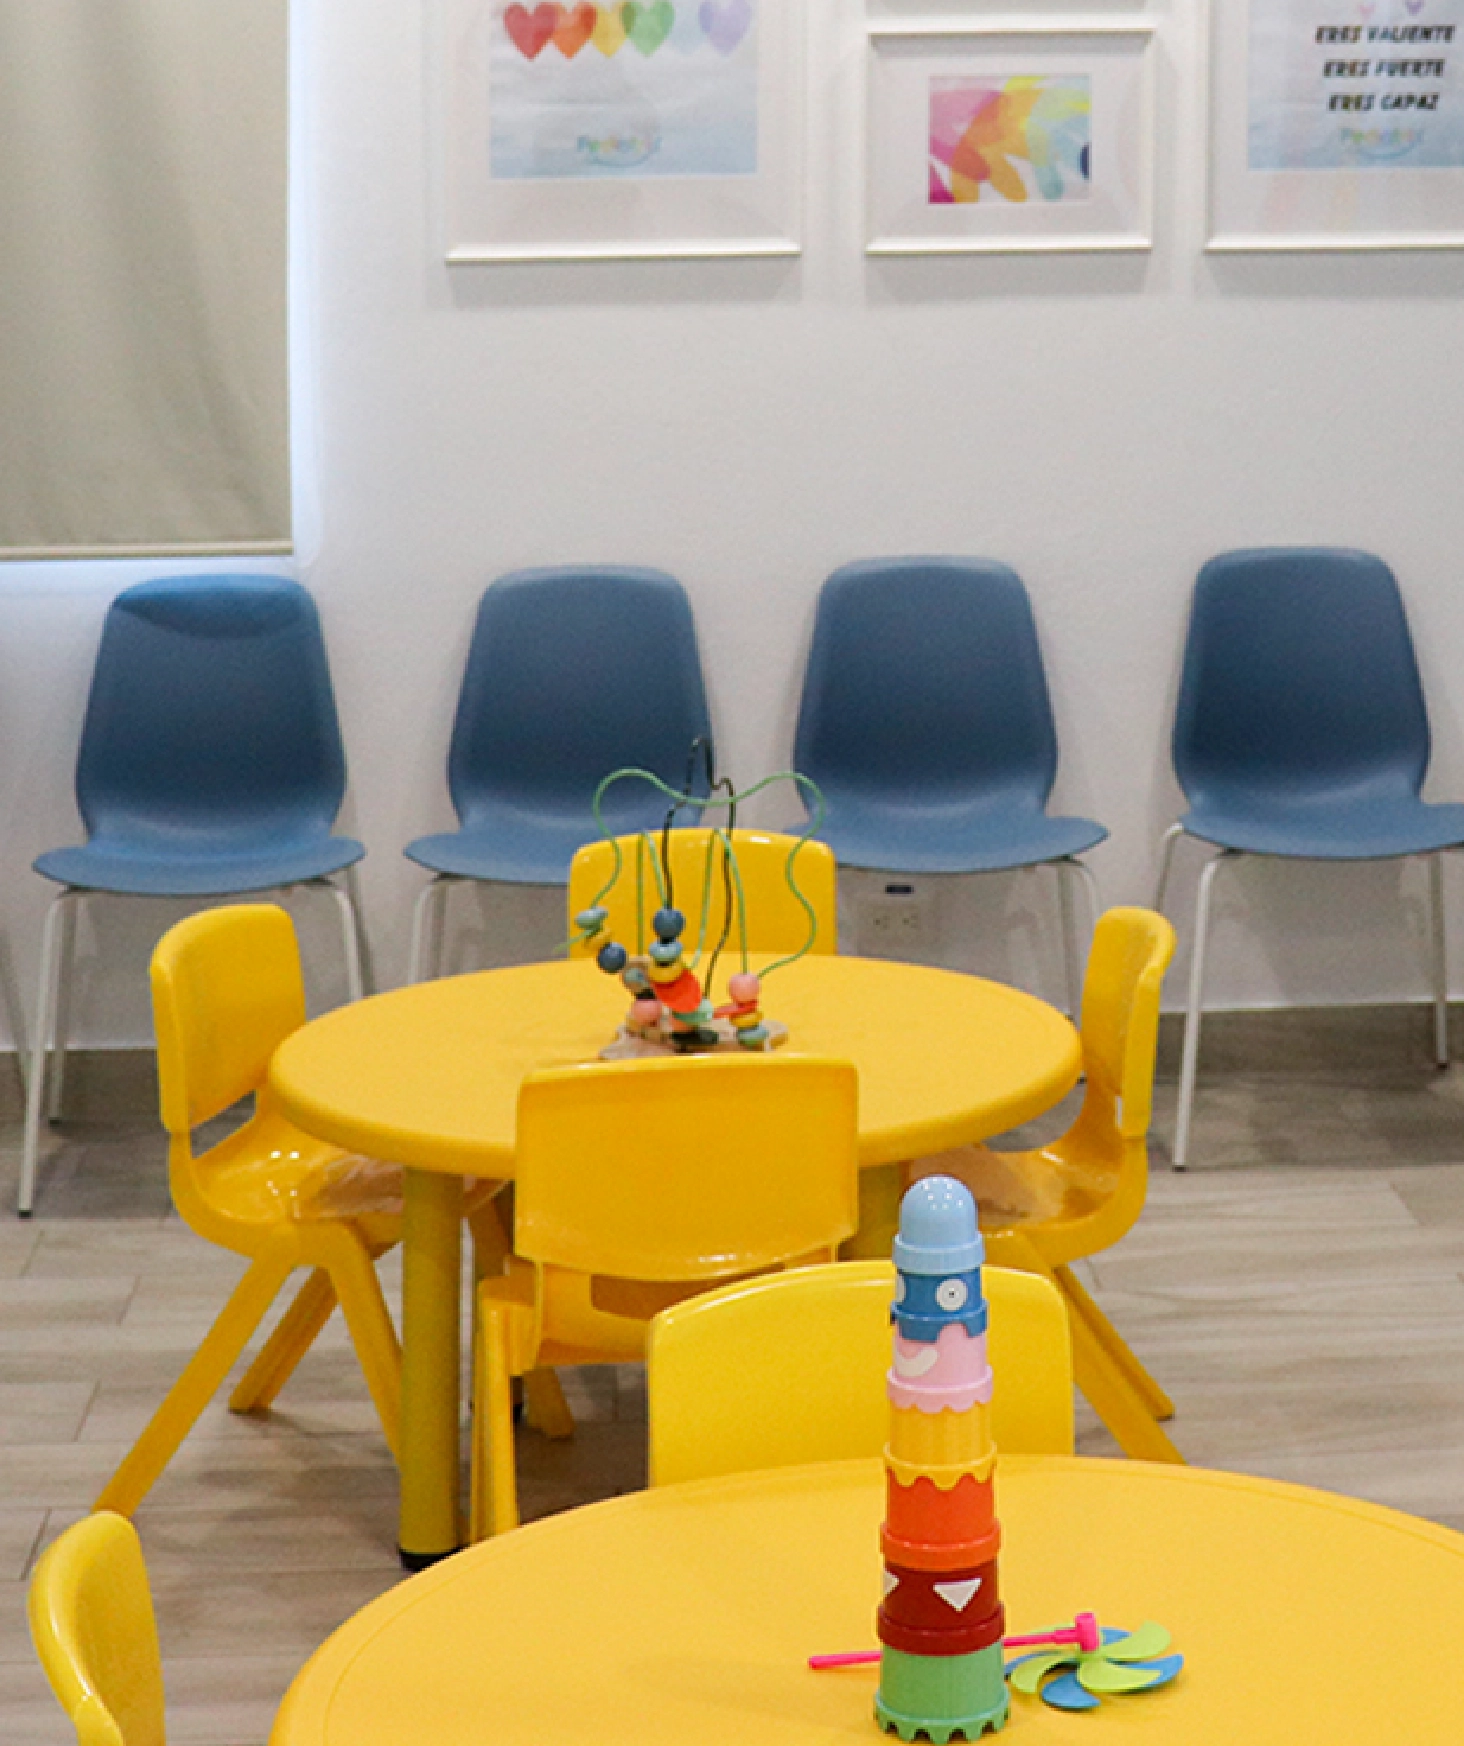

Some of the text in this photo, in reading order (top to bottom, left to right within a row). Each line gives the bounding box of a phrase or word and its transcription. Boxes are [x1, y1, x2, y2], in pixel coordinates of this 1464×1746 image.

[1315, 24, 1456, 44] ERES VALIENTE
[1322, 59, 1446, 78] ERES FUERTE
[1326, 92, 1440, 112] ERES CAPAZ
